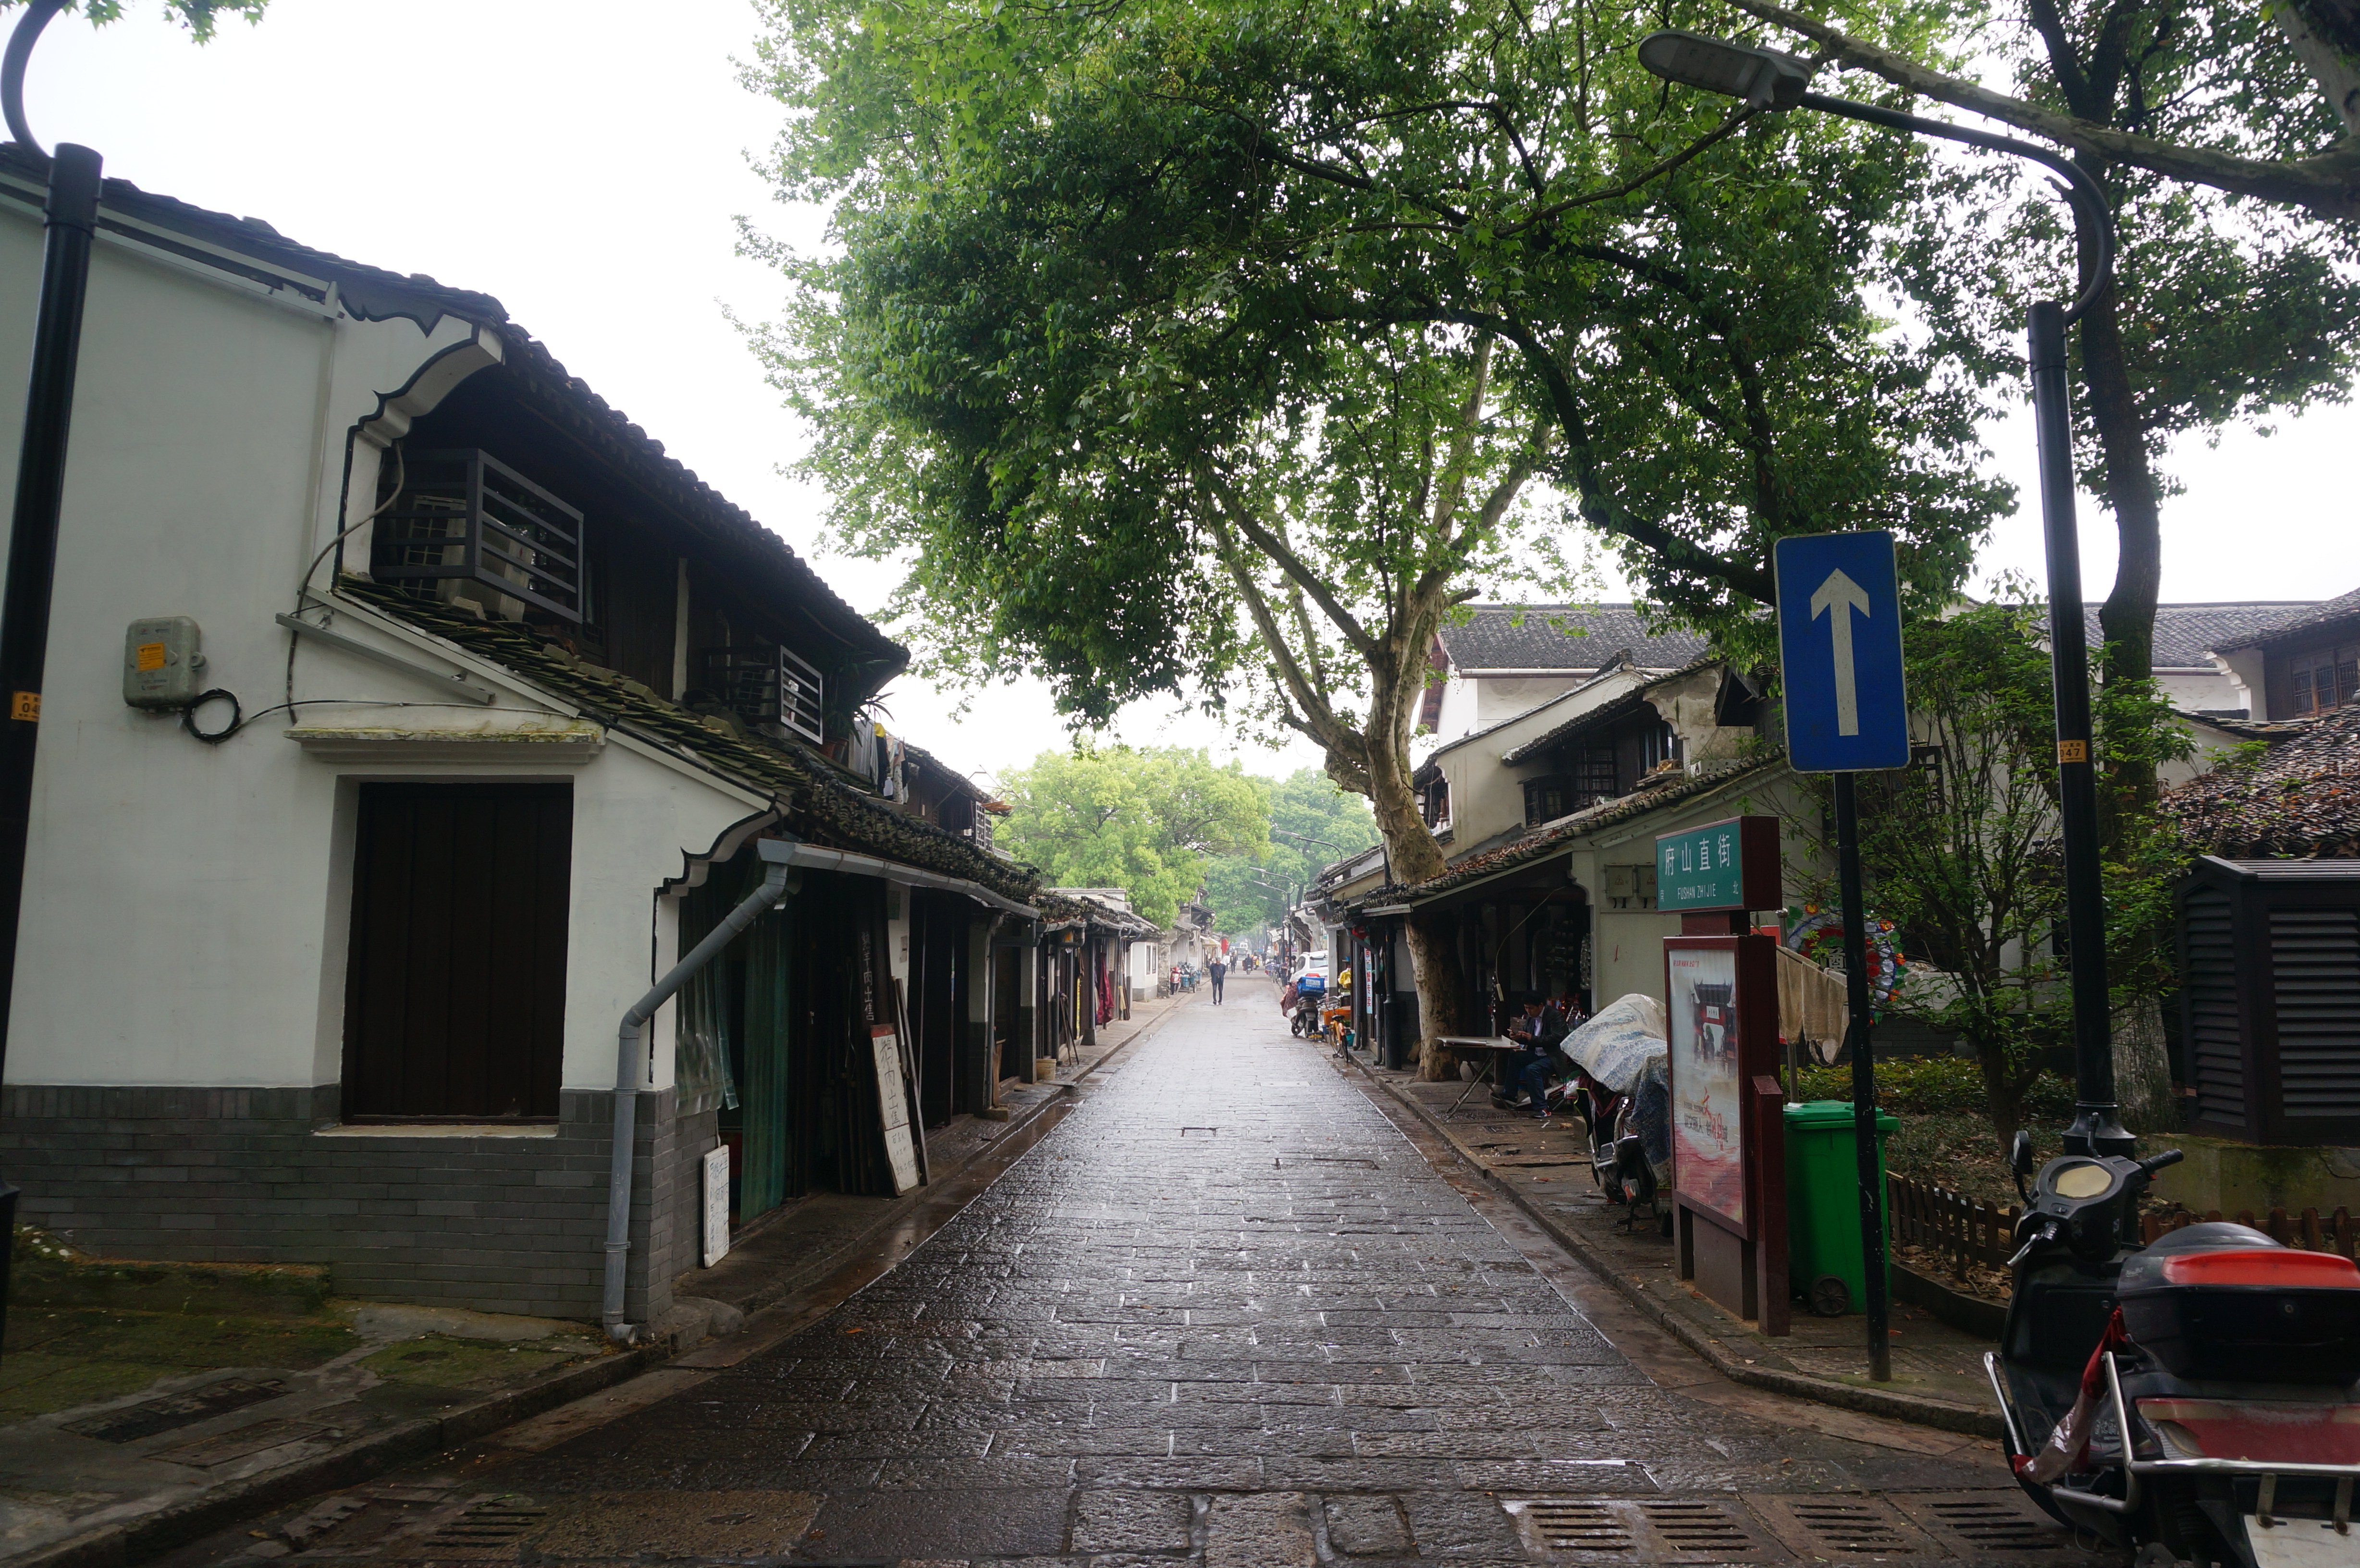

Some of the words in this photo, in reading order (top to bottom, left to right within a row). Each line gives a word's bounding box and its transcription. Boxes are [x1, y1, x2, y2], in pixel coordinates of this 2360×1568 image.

[2060, 748, 2080, 757] 047
[1665, 833, 1730, 876] 府山直街
[1678, 886, 1696, 899] FUSHAN
[1697, 883, 1716, 898] ZHIJIE
[1733, 881, 1739, 894] 北
